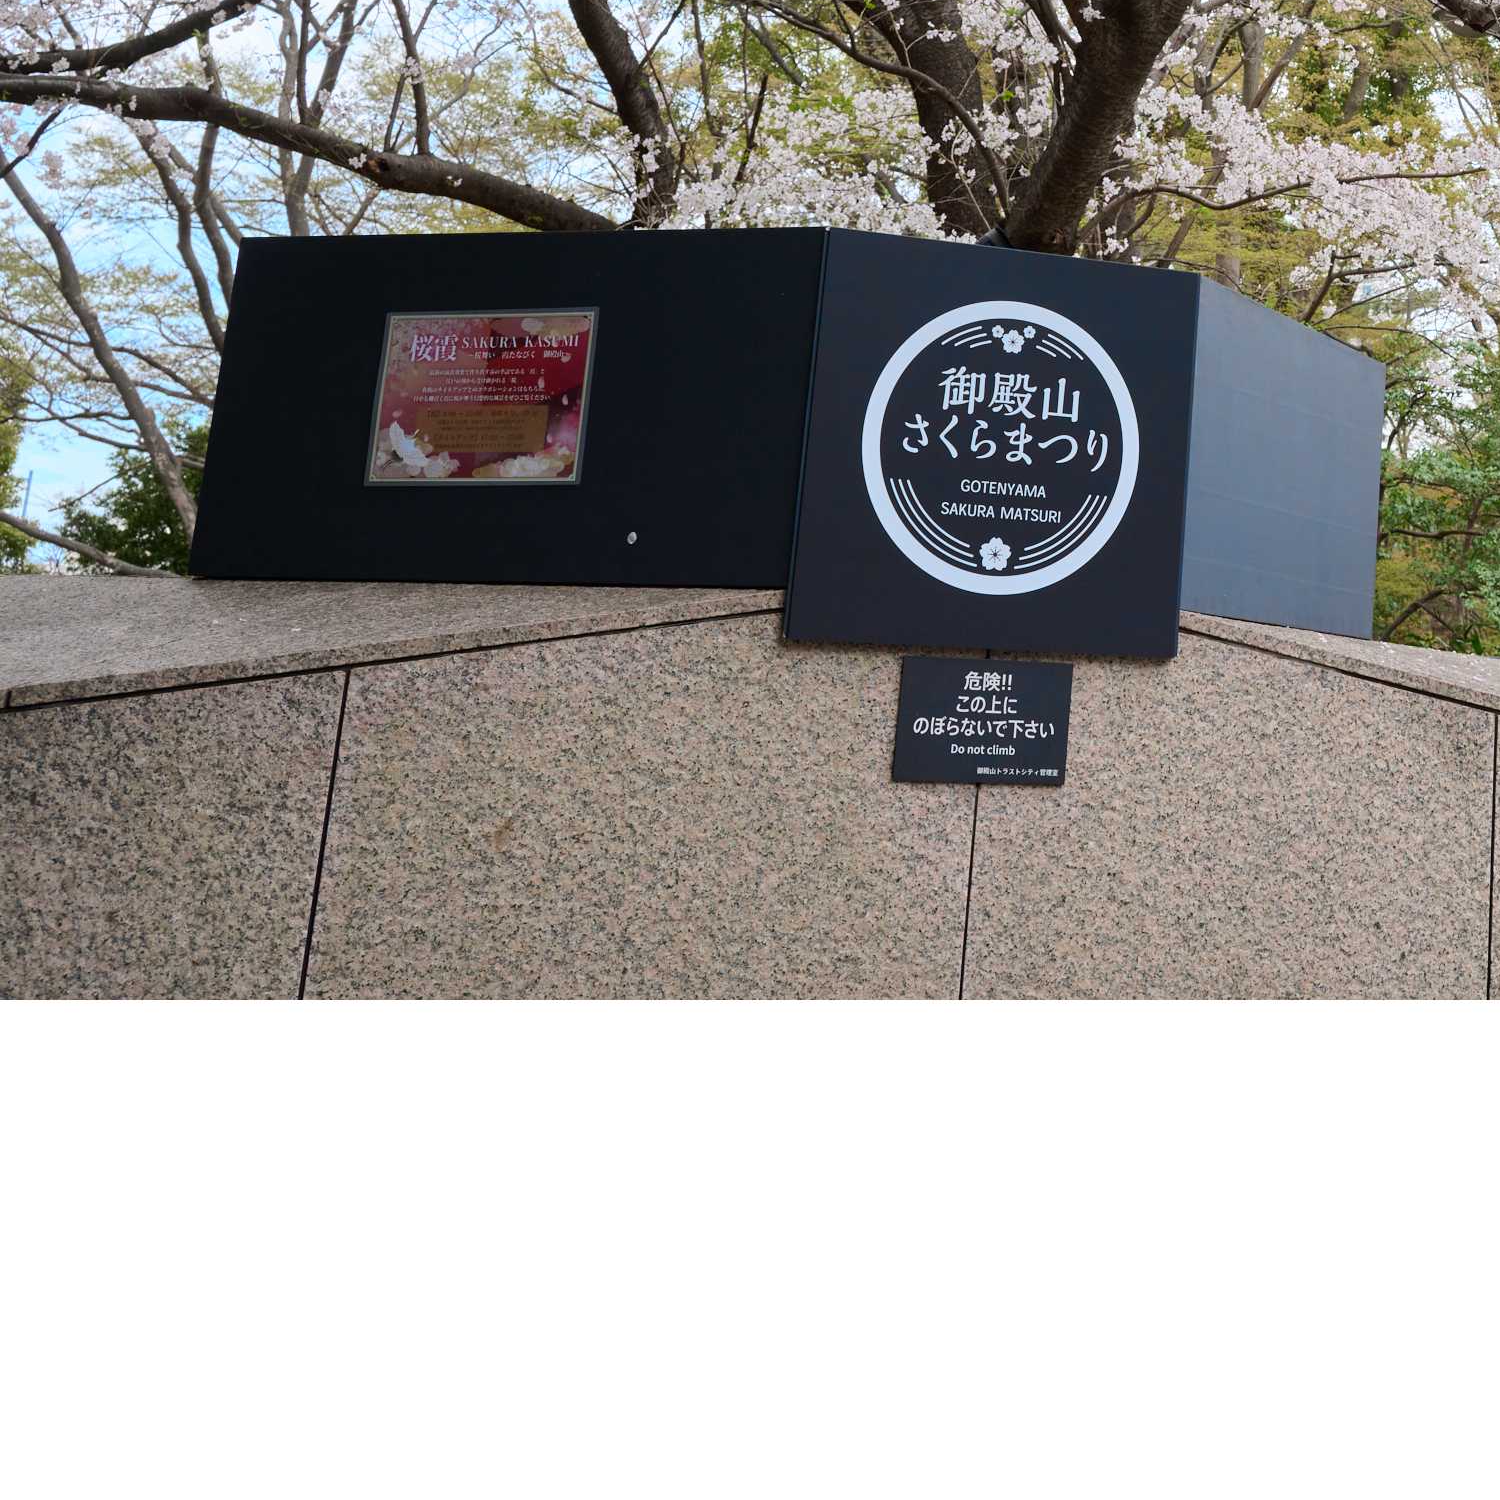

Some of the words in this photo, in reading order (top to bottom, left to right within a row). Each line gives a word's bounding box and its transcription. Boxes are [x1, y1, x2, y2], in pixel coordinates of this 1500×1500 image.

[410, 333, 458, 362] 桜霞
[461, 336, 518, 349] SAKURA
[525, 334, 580, 348] KASUMI
[938, 365, 1081, 422] 御殿山
[902, 413, 1109, 472] さくらまつり
[960, 478, 1046, 498] GOTENYAMA
[940, 502, 995, 519] SAKURA
[1000, 506, 1062, 524] MATSURI
[963, 671, 1013, 692] 危険!!
[956, 695, 1018, 714] この上に
[913, 716, 1055, 739] のぼらないで下さい
[950, 744, 965, 754] Do
[967, 744, 985, 755] not
[987, 745, 1016, 756] climb
